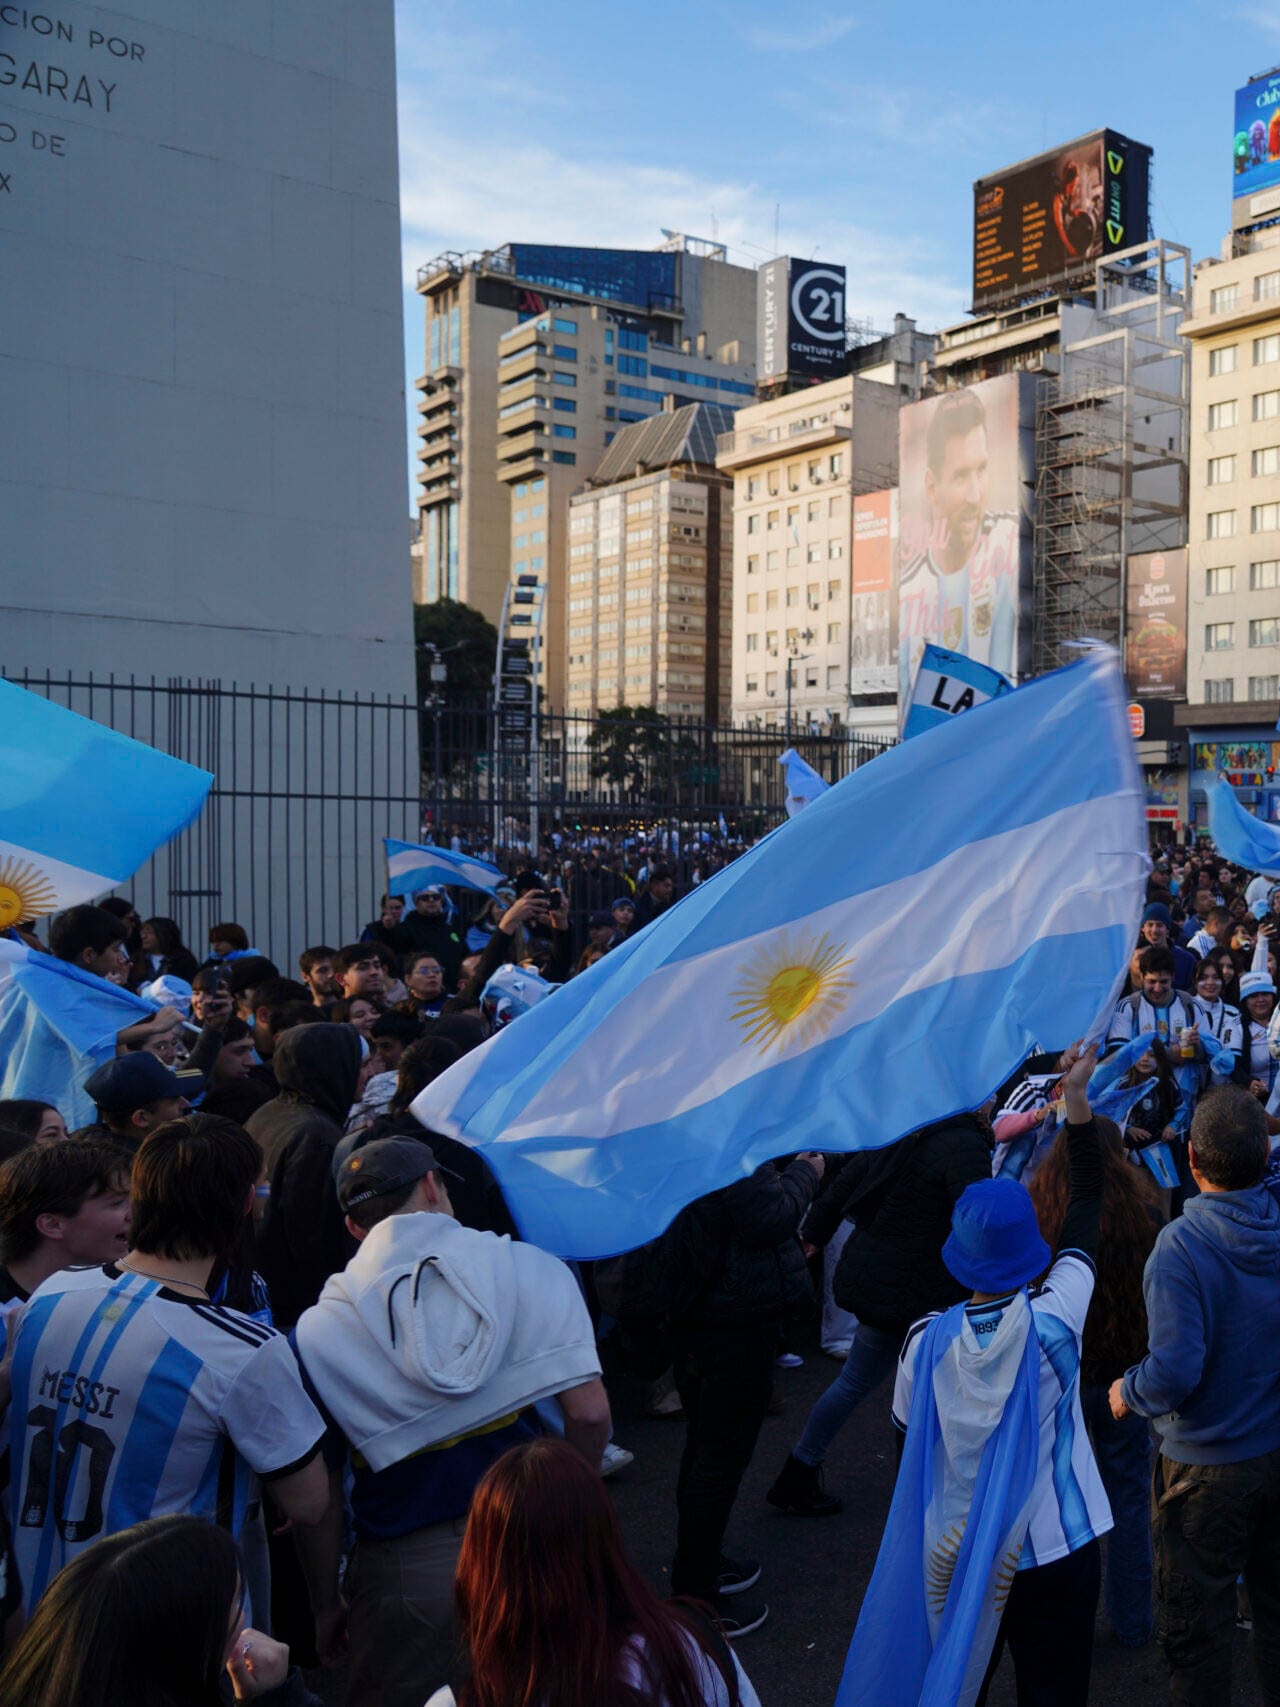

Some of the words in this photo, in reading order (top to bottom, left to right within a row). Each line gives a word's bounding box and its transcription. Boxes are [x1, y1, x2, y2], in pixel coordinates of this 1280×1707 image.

[0, 6, 73, 43] CION
[89, 30, 146, 62] POR
[0, 52, 117, 113] GARAY
[1256, 88, 1280, 108] Club
[31, 129, 66, 157] DE
[809, 288, 843, 323] 21
[764, 290, 774, 374] CENTURY
[791, 342, 834, 357] CENTURY
[836, 350, 845, 359] 21
[900, 513, 952, 560] You
[968, 525, 1019, 595] Got
[900, 590, 953, 640] This
[931, 676, 974, 714] LA
[38, 1366, 121, 1419] MESSI
[20, 1404, 116, 1542] 10
